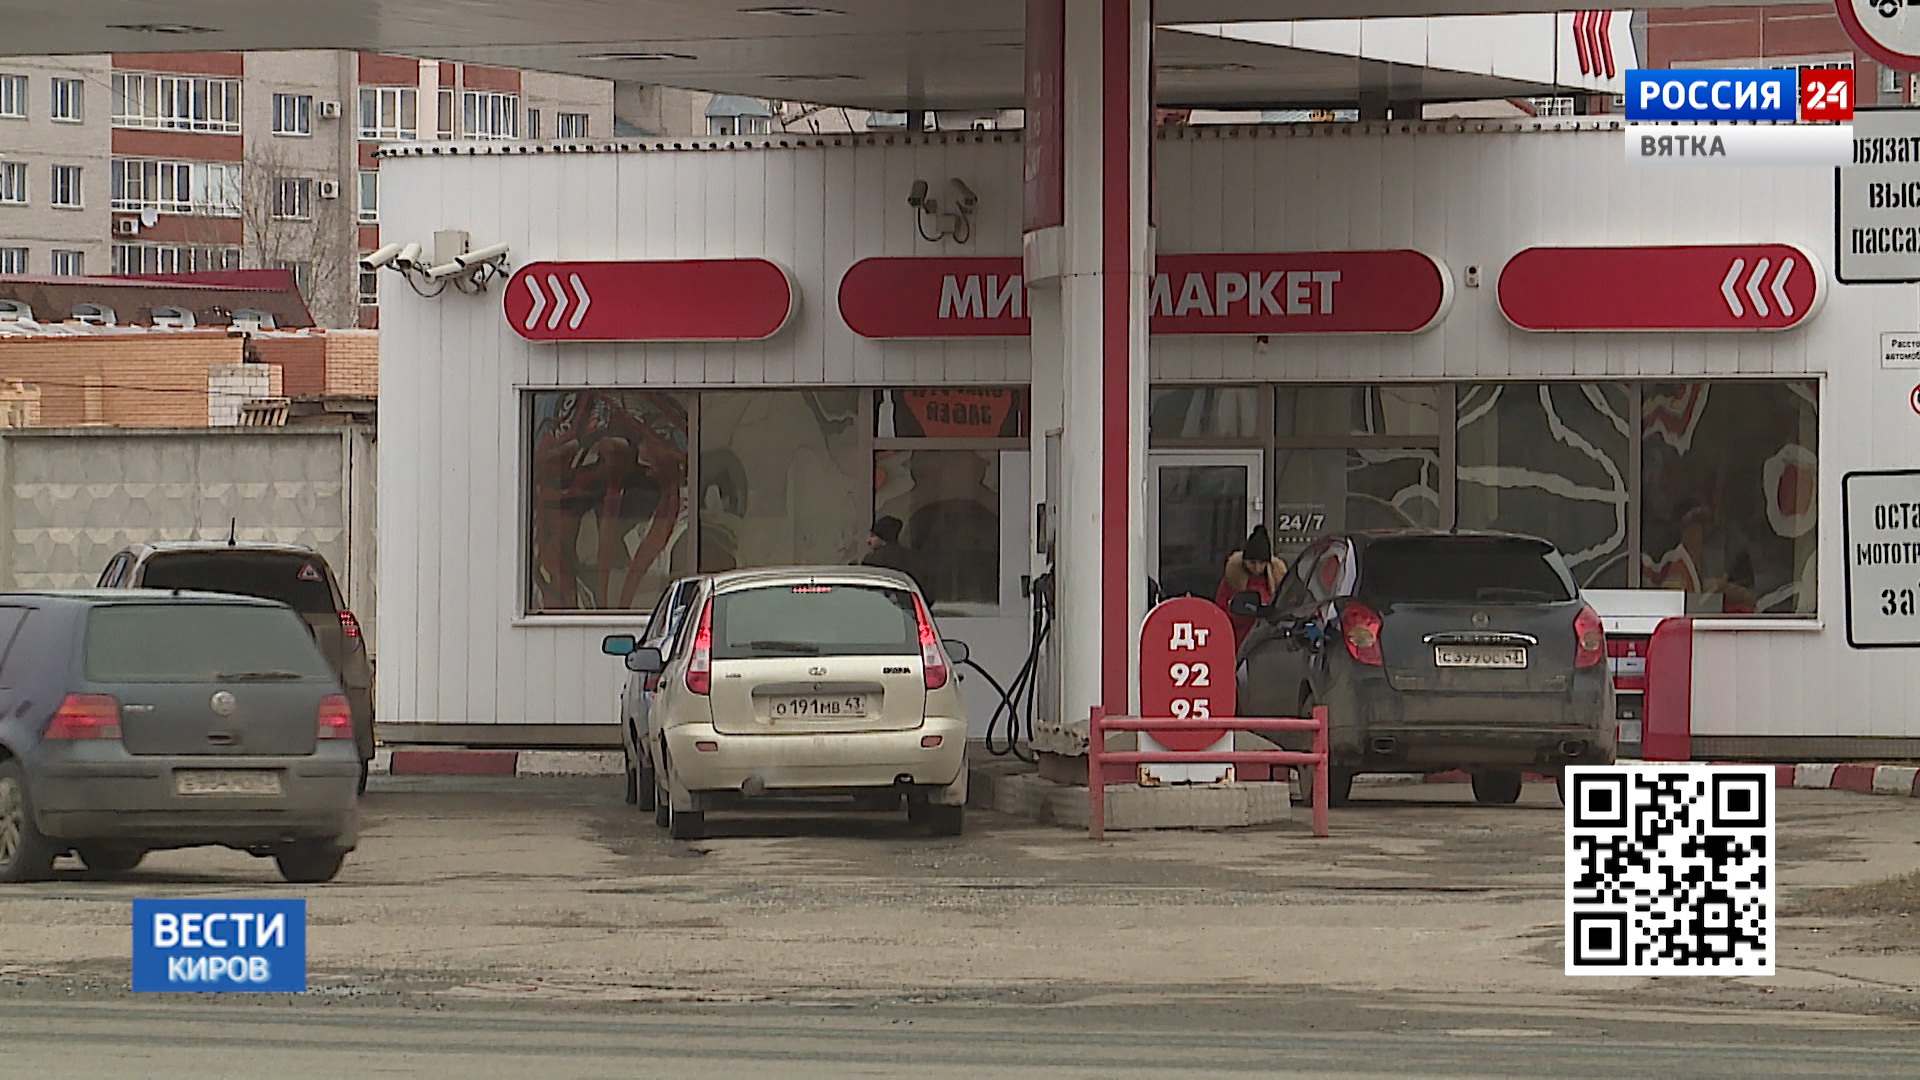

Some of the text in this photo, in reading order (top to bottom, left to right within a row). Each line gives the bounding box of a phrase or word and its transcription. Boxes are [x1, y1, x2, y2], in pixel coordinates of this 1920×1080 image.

[1852, 227, 1920, 254] пасса
[939, 274, 1032, 318] МИ
[1279, 513, 1324, 533] 24/7
[1170, 622, 1209, 650] Дт
[1170, 663, 1210, 686] 92
[1170, 699, 1210, 720] 95
